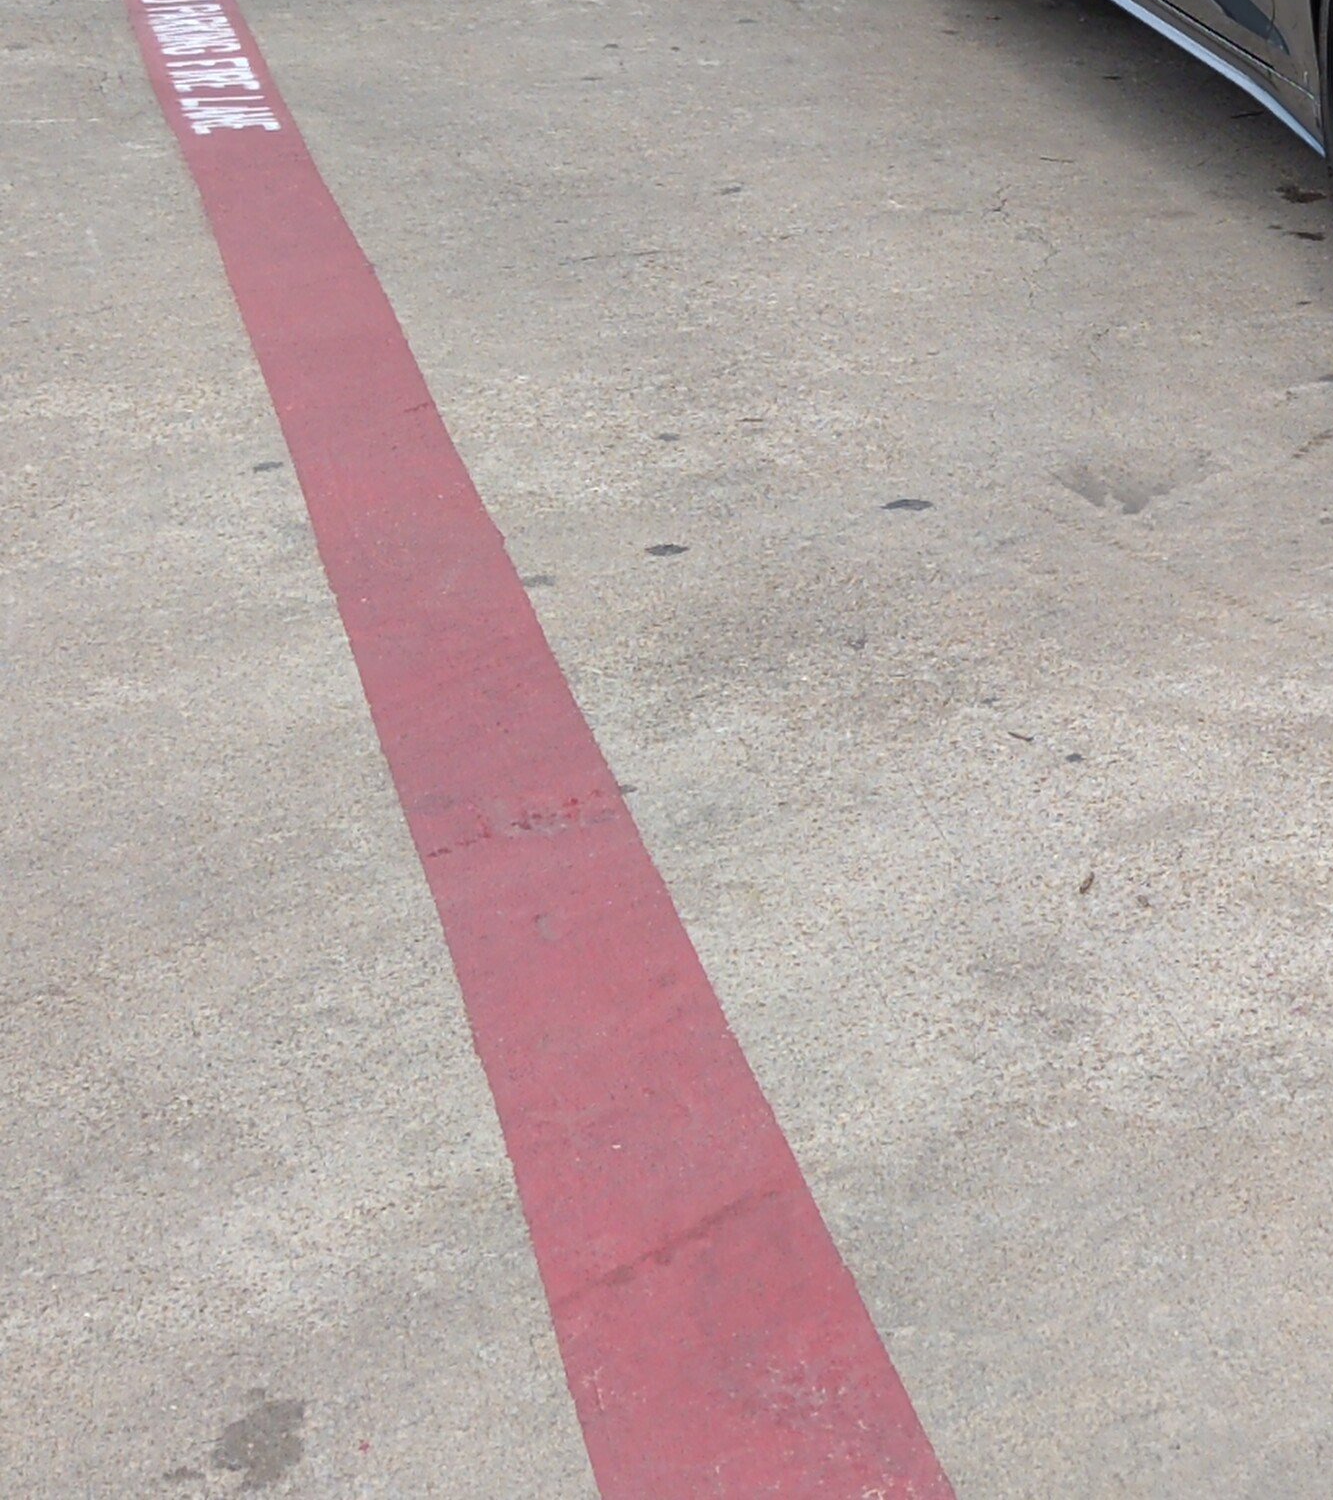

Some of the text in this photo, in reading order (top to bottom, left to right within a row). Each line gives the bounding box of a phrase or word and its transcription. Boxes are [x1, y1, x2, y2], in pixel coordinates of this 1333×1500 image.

[146, 3, 241, 55] PARKING
[165, 57, 260, 92] FIRE
[178, 95, 281, 135] LANE
